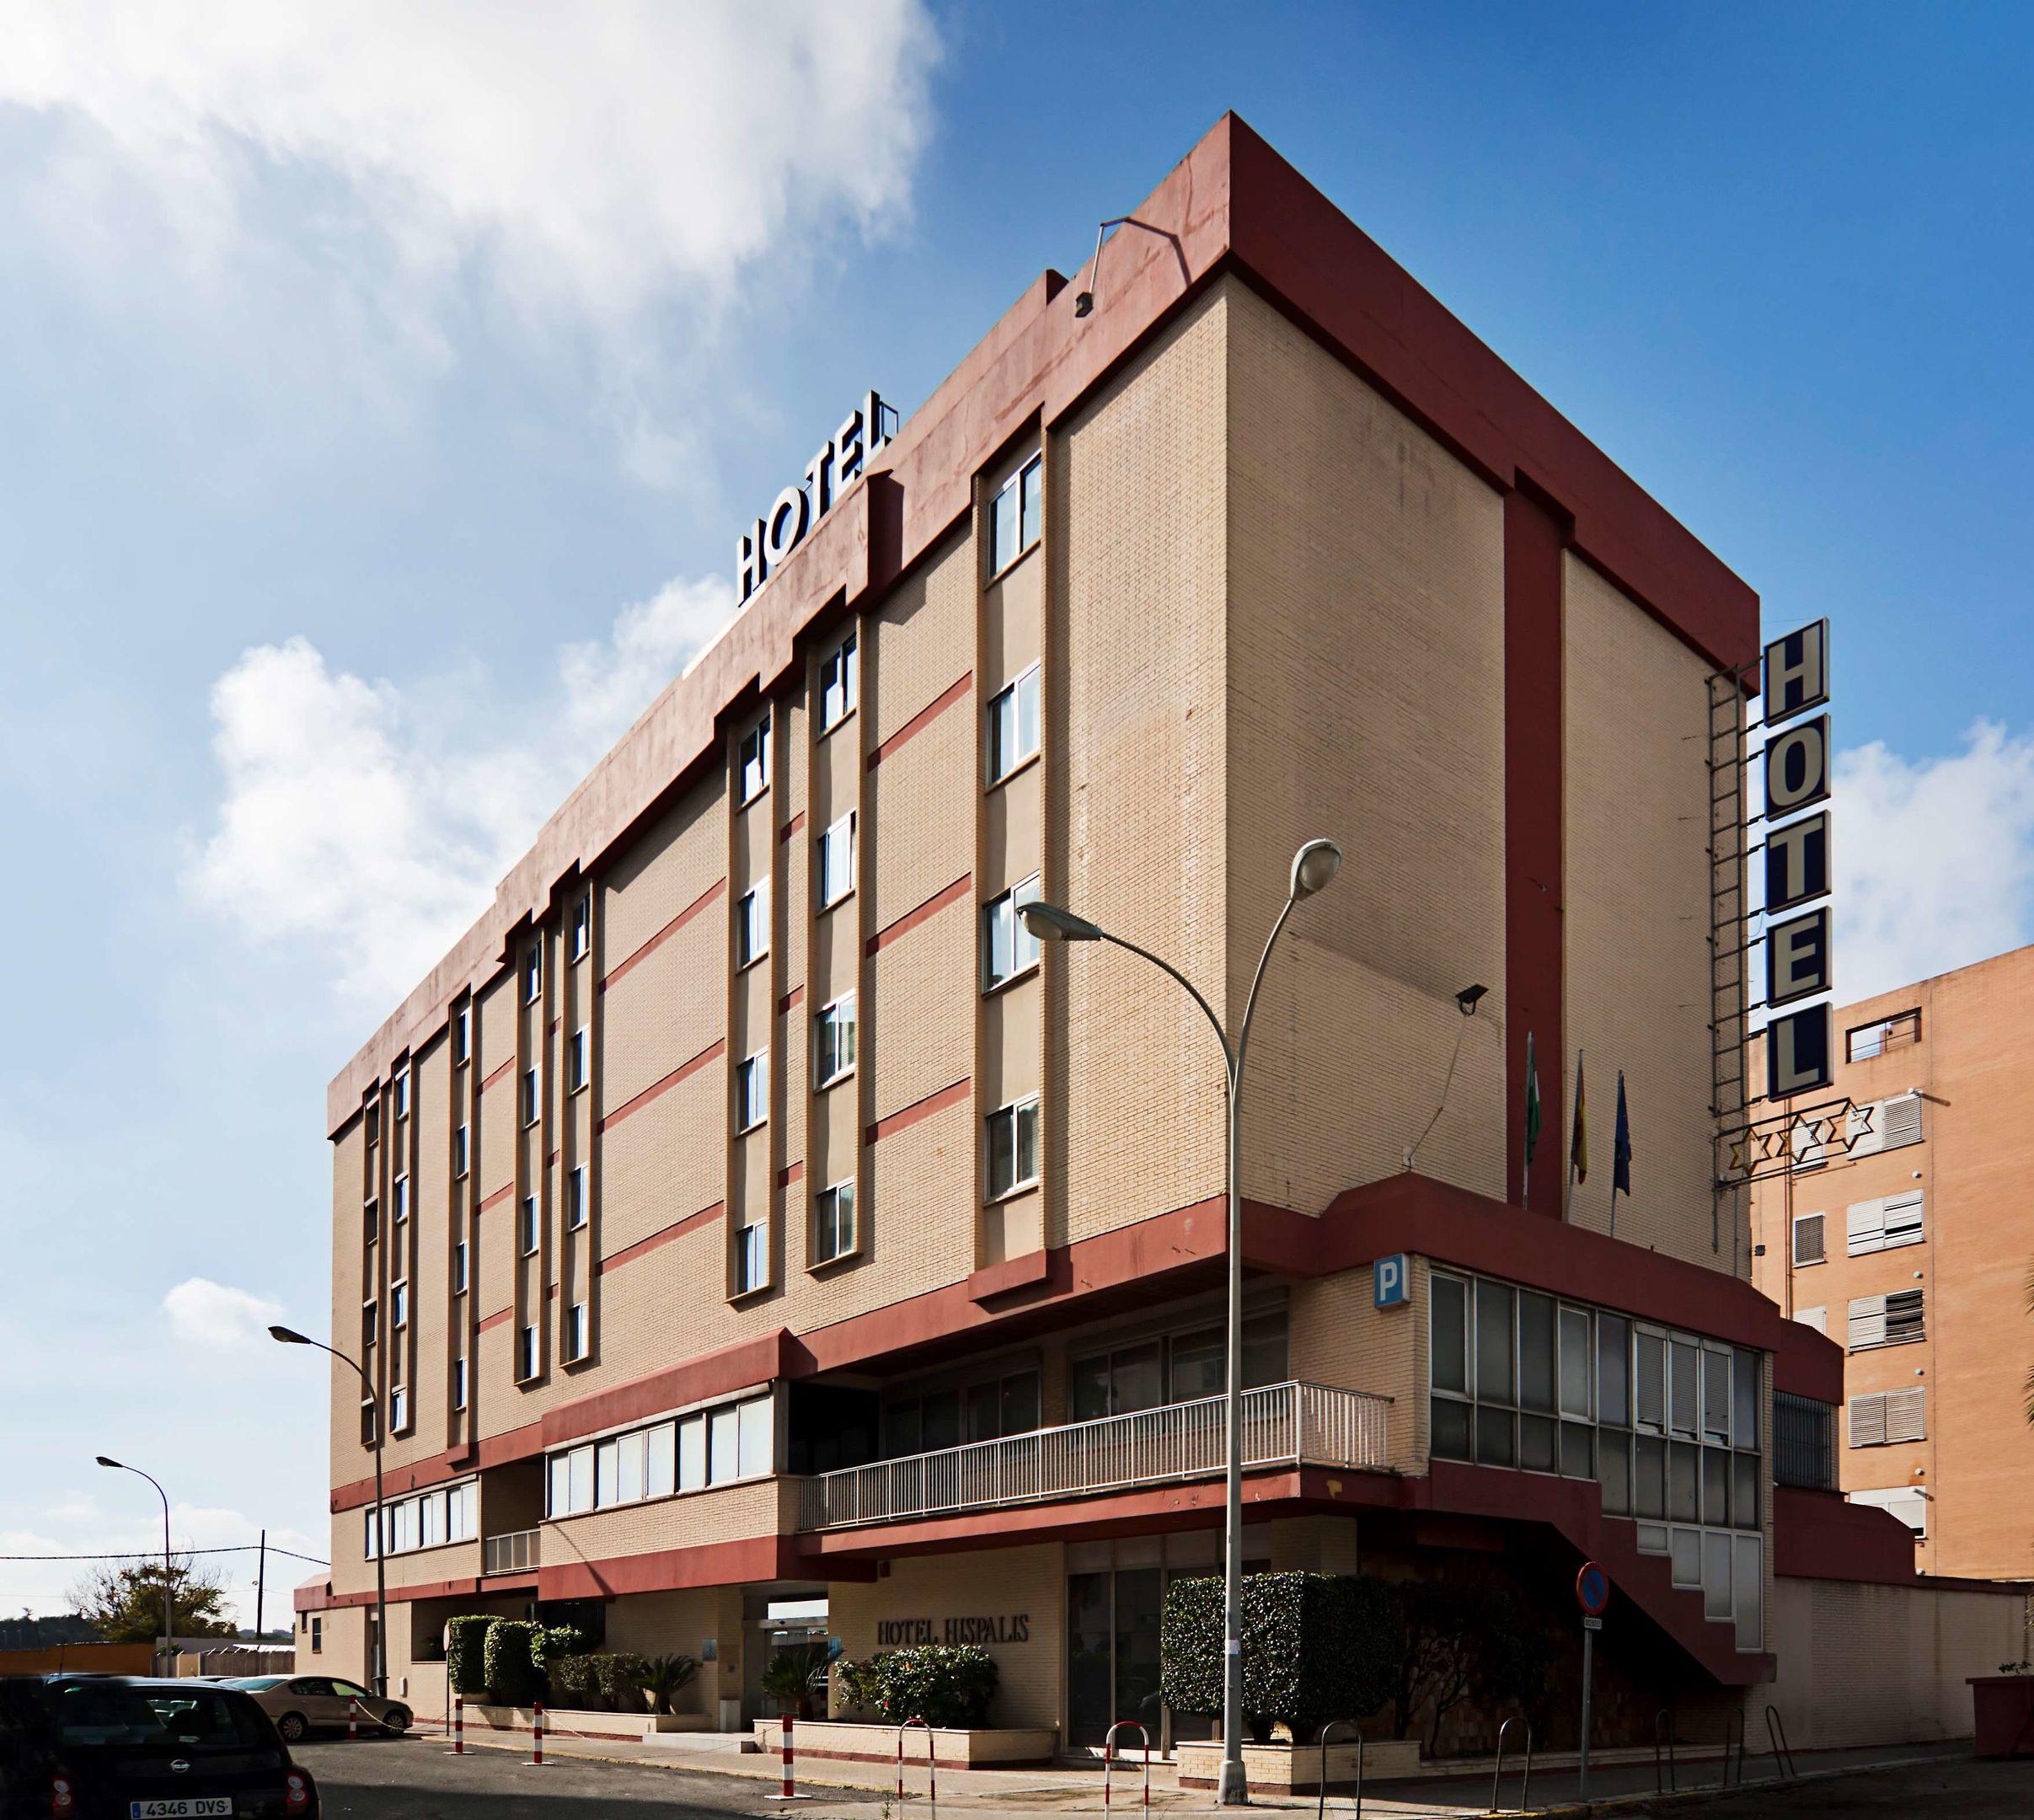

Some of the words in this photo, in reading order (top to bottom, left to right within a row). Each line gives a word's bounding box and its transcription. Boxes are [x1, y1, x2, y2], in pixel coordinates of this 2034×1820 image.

[736, 389, 892, 607] HOTEL
[1768, 624, 1823, 1093] HOTEL
[1379, 1261, 1398, 1302] P
[877, 1618, 939, 1645] HOTEL
[944, 1613, 1030, 1645] HISPALIS
[146, 1801, 188, 1817] 4346
[195, 1800, 226, 1814] DVS
